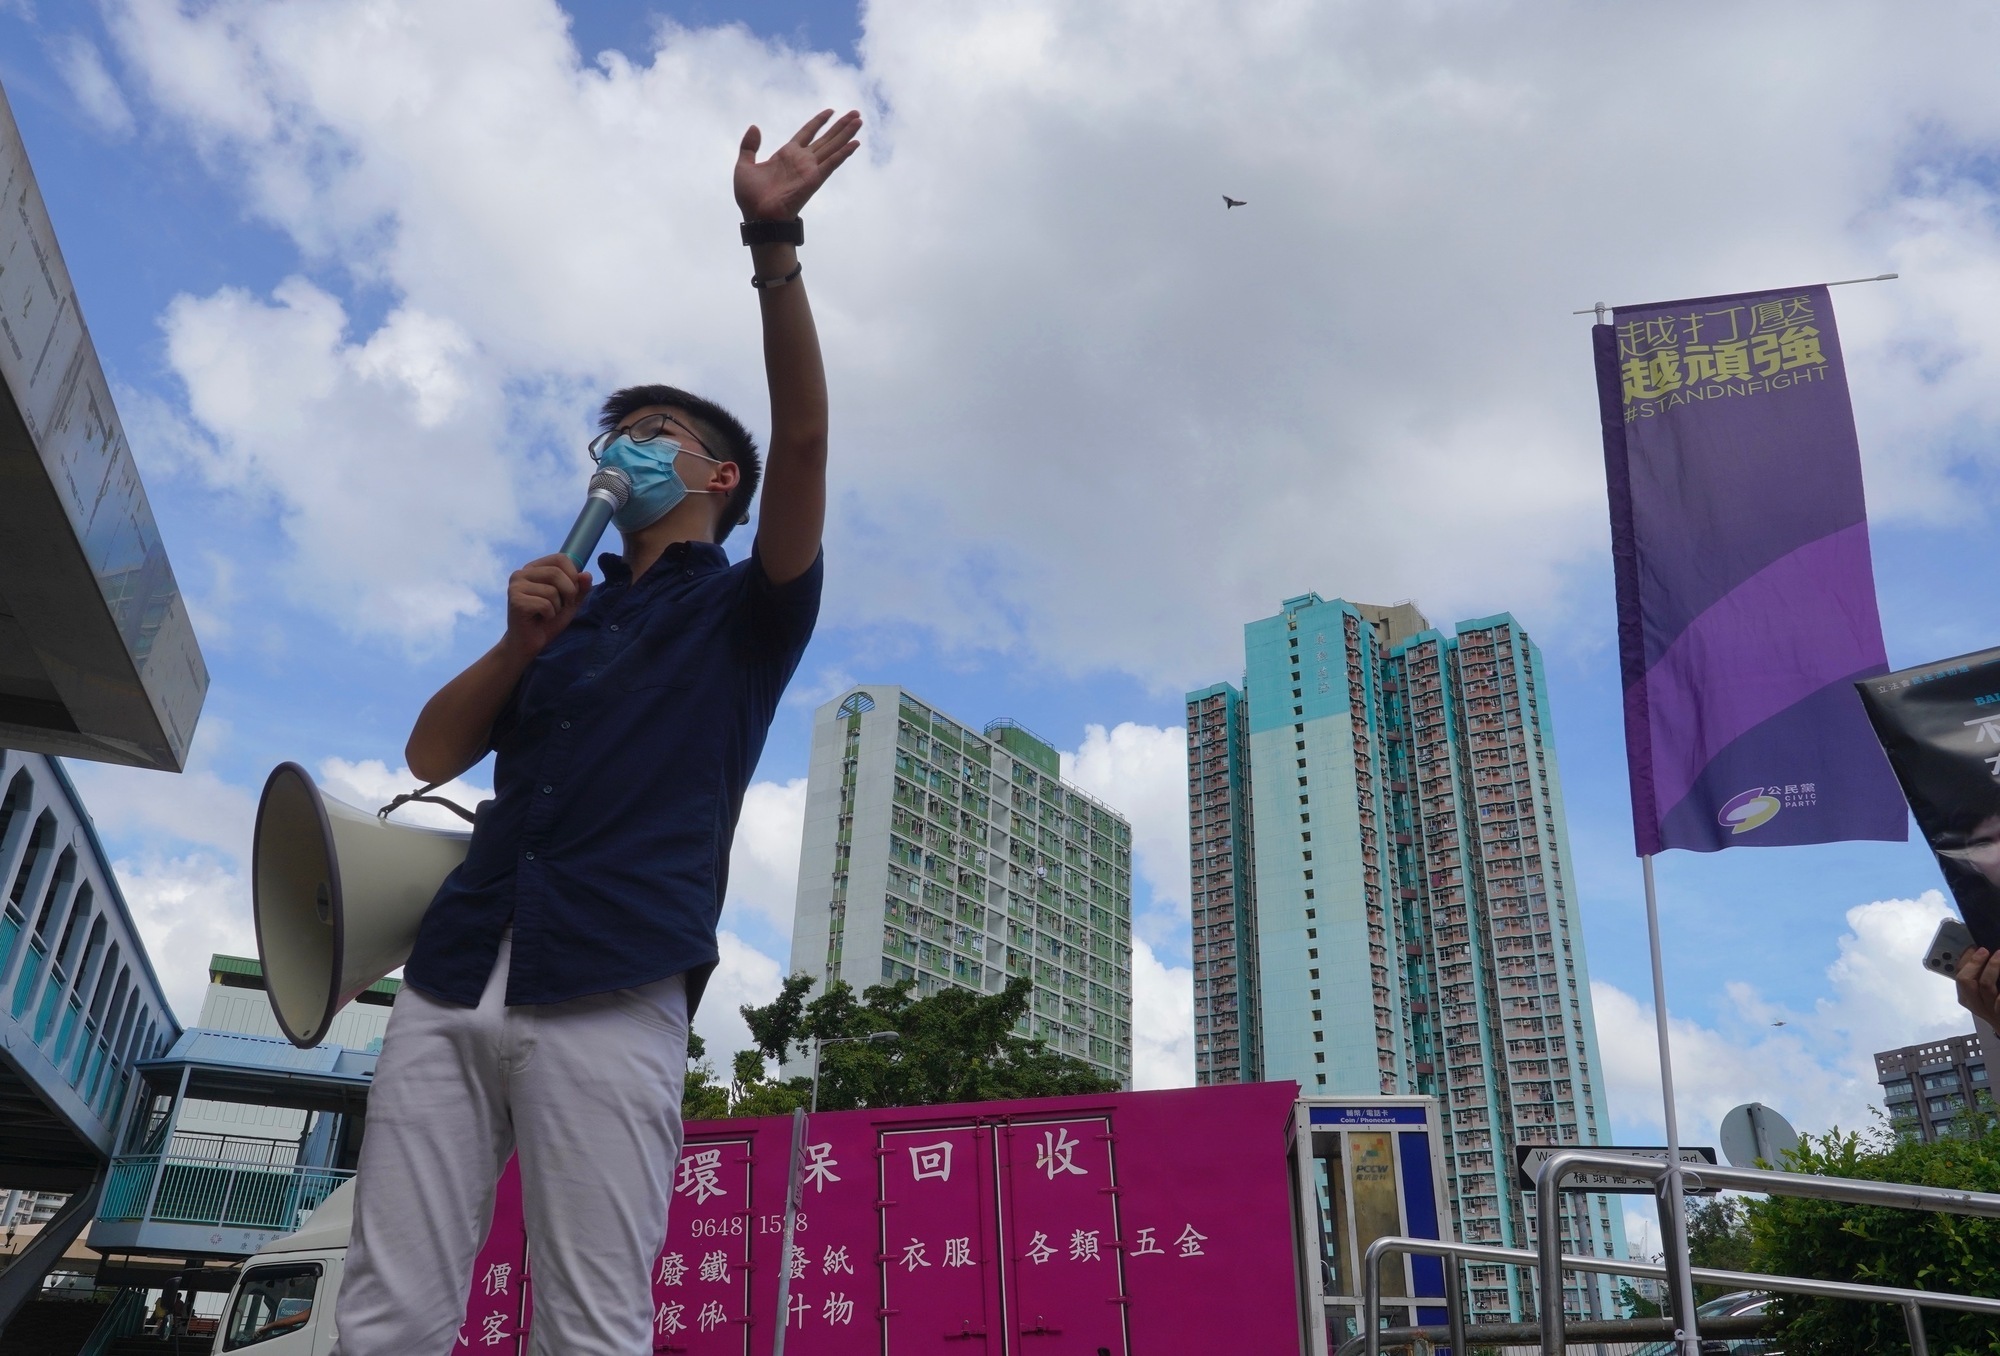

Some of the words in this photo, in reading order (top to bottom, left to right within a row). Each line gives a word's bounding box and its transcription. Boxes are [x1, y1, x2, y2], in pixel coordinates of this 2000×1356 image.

[1616, 295, 1816, 361] 越打壓
[1621, 325, 1827, 405] 越頑強
[1624, 366, 1829, 424] #STANDNFIGHT
[1767, 783, 1816, 795] 公民黨
[1785, 793, 1816, 801] CIVIC
[1785, 800, 1817, 808] PARTY
[1356, 1165, 1389, 1173] PCCW
[691, 1216, 743, 1238] 9648
[759, 1213, 808, 1234] 158
[482, 1262, 512, 1297] 價
[899, 1236, 976, 1273] 衣服
[1024, 1228, 1101, 1266] 各類
[1130, 1223, 1208, 1259] 五金
